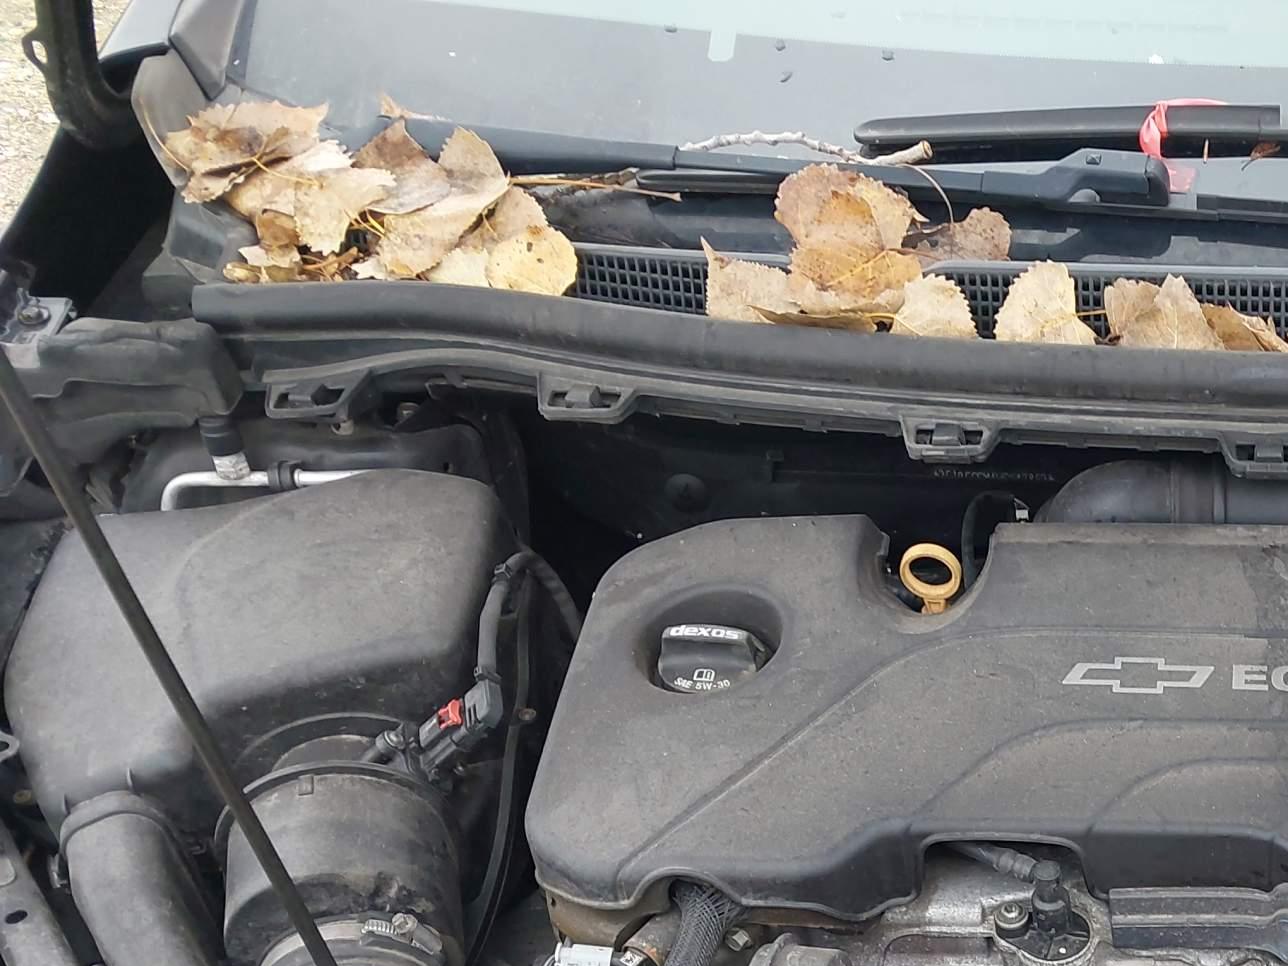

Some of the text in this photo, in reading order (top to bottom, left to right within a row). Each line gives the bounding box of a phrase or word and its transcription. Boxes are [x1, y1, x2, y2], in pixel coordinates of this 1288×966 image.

[669, 624, 739, 639] dexos
[673, 677, 731, 691] SAE 5W-30
